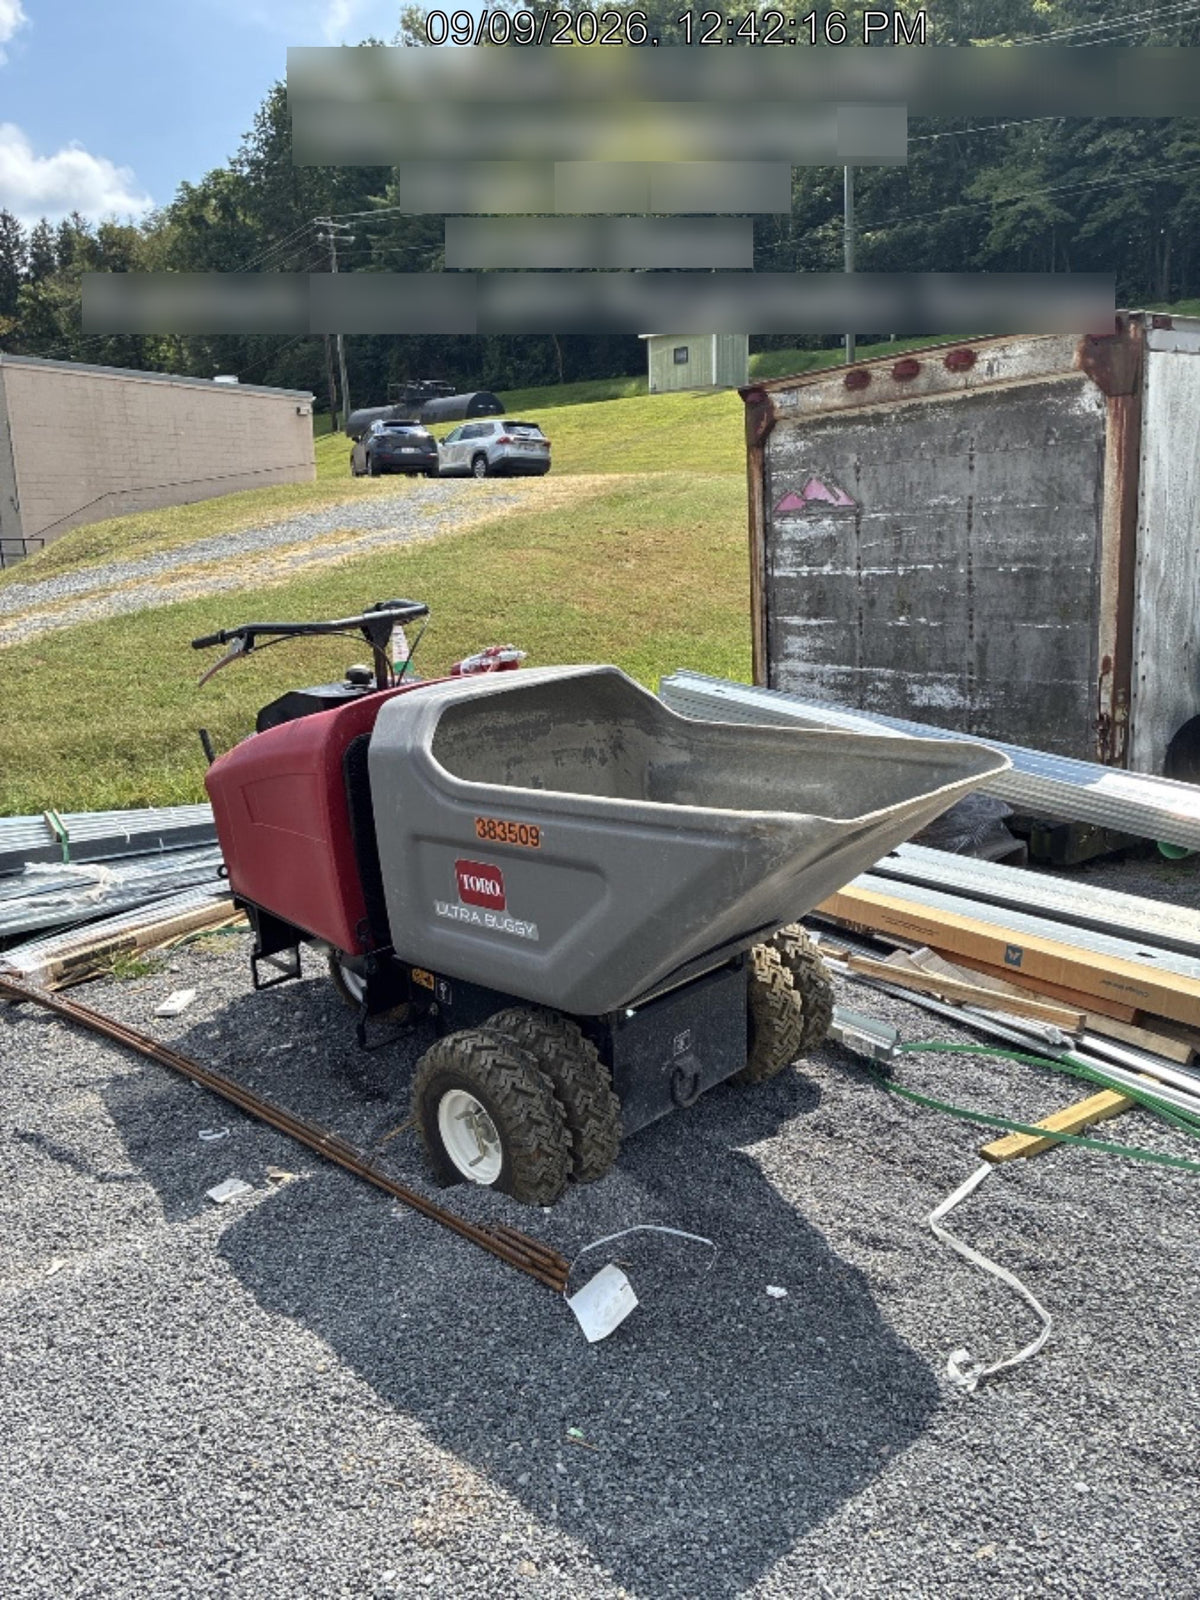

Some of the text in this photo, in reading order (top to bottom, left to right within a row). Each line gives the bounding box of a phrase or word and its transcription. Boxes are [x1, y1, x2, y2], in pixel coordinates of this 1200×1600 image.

[476, 818, 540, 847] 383509
[460, 874, 503, 896] TORO
[435, 901, 535, 937] ULTRA BUGGY
